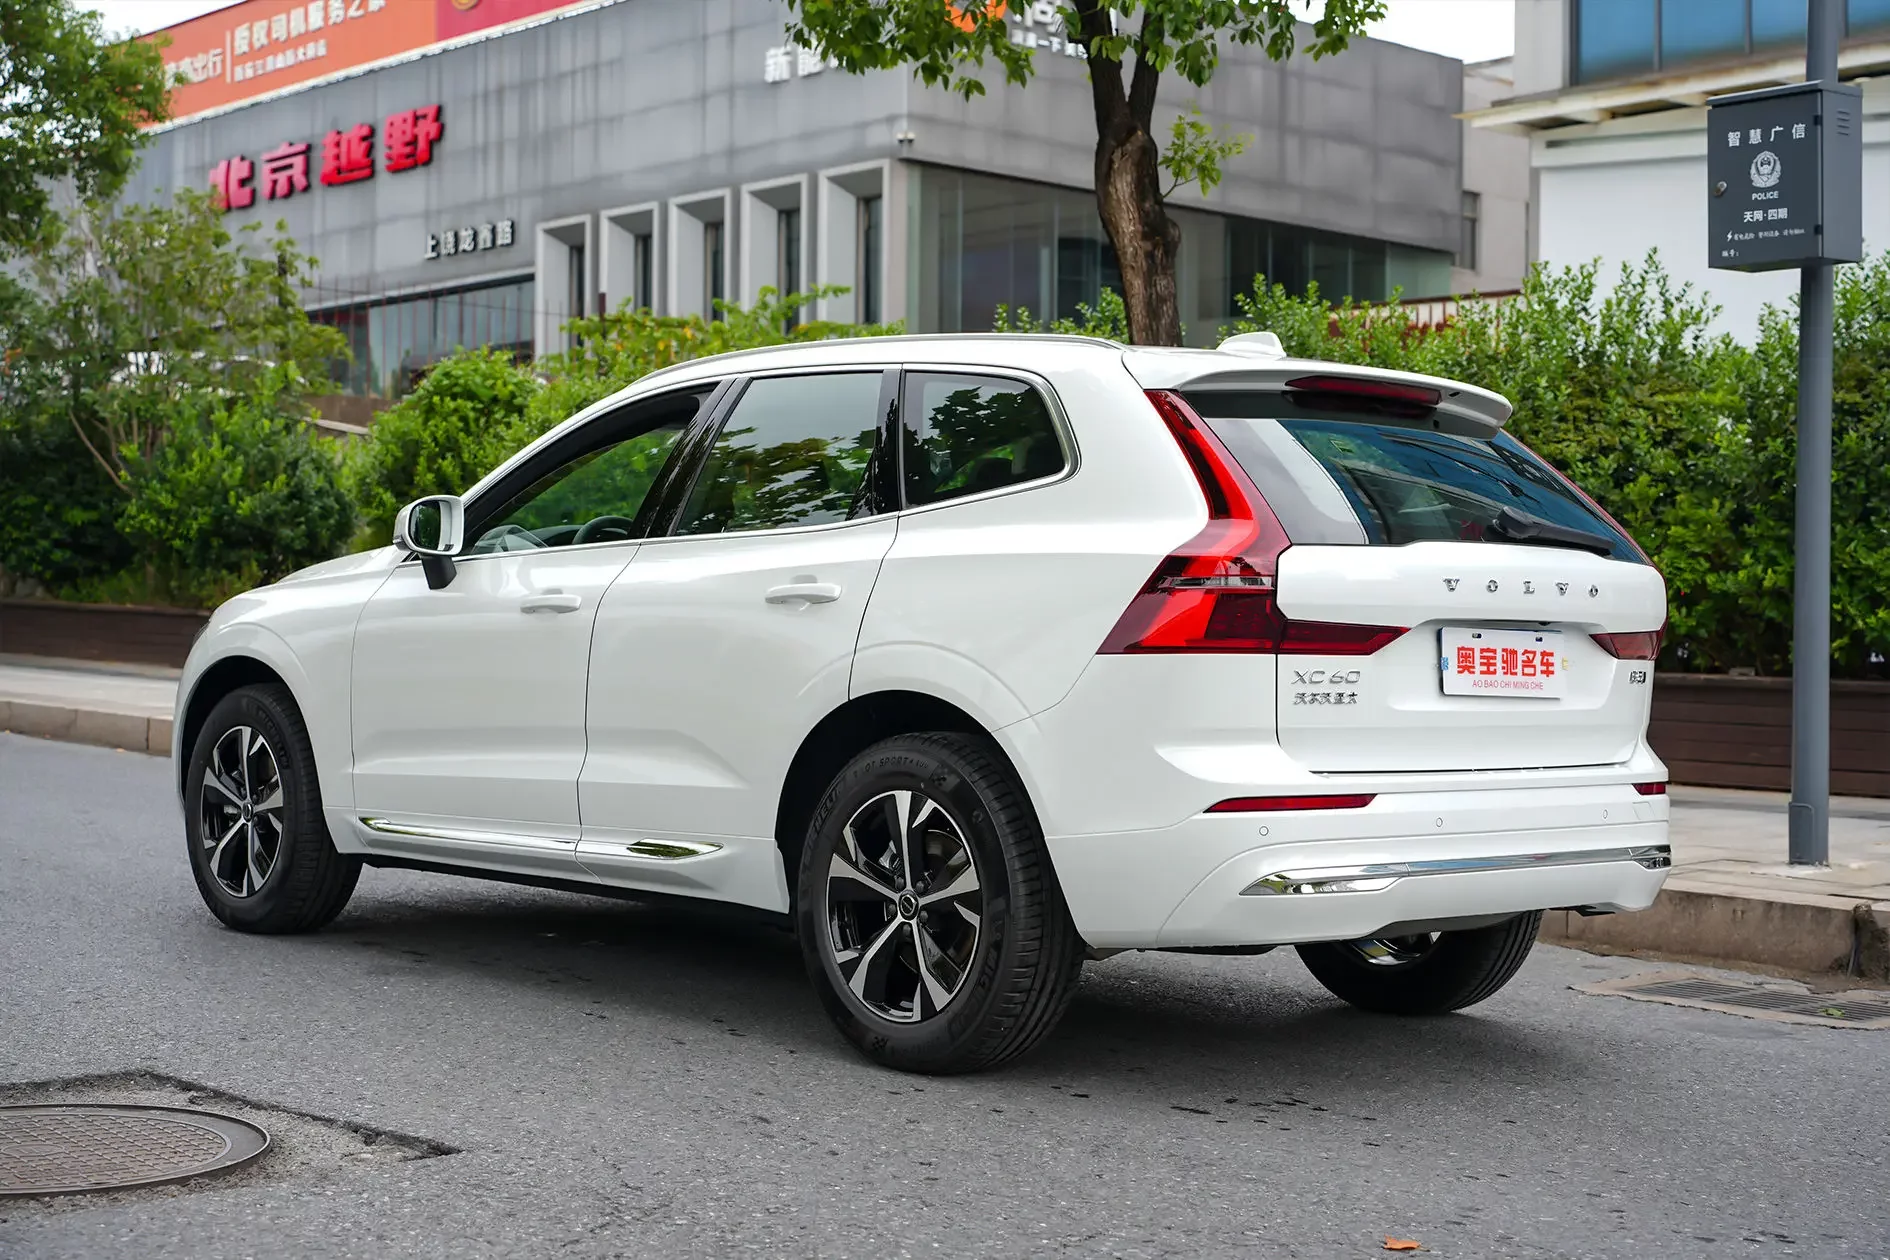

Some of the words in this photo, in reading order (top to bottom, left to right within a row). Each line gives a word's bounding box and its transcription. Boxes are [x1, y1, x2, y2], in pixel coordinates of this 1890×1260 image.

[1727, 122, 1806, 147] 智慧广信
[208, 103, 442, 211] 北京越野
[1751, 190, 1779, 201] POLICE
[1443, 577, 1600, 598] VOLVO
[1456, 645, 1555, 678] 奥宝驰名车
[1472, 679, 1483, 688] AO
[1484, 679, 1499, 689] BAO
[1500, 680, 1512, 689] CHI
[1513, 680, 1530, 690] MING
[1531, 681, 1544, 691] CHE
[1293, 691, 1358, 705] 沃尔沃亚太
